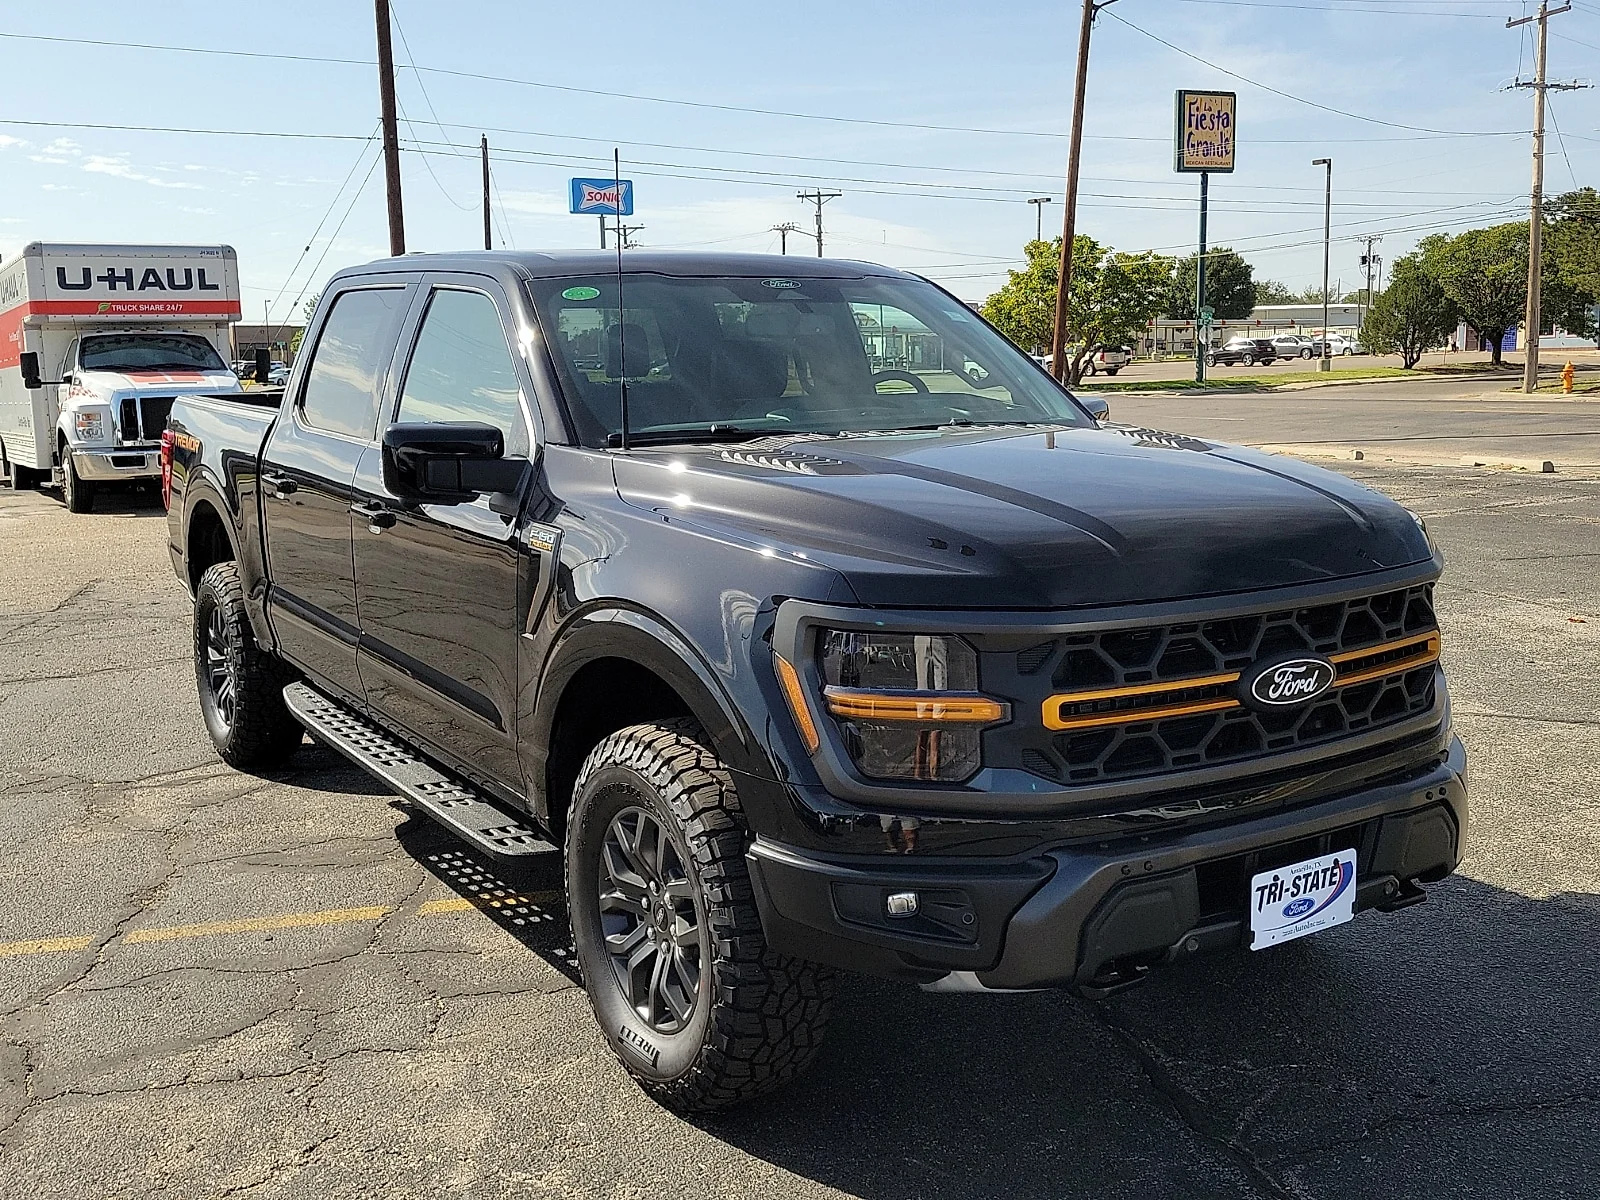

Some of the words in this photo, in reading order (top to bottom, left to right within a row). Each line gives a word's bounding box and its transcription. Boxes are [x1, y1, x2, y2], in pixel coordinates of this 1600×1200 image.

[1188, 97, 1230, 131] Fiesta
[586, 192, 621, 203] SONIC
[111, 304, 138, 312] TRUCK
[139, 304, 165, 312] SHARE
[166, 303, 183, 312] 24/7
[175, 434, 200, 453] TREMOR
[1269, 665, 1319, 699] Ford
[1255, 864, 1338, 914] TRI-STATE
[1288, 900, 1309, 915] Ford
